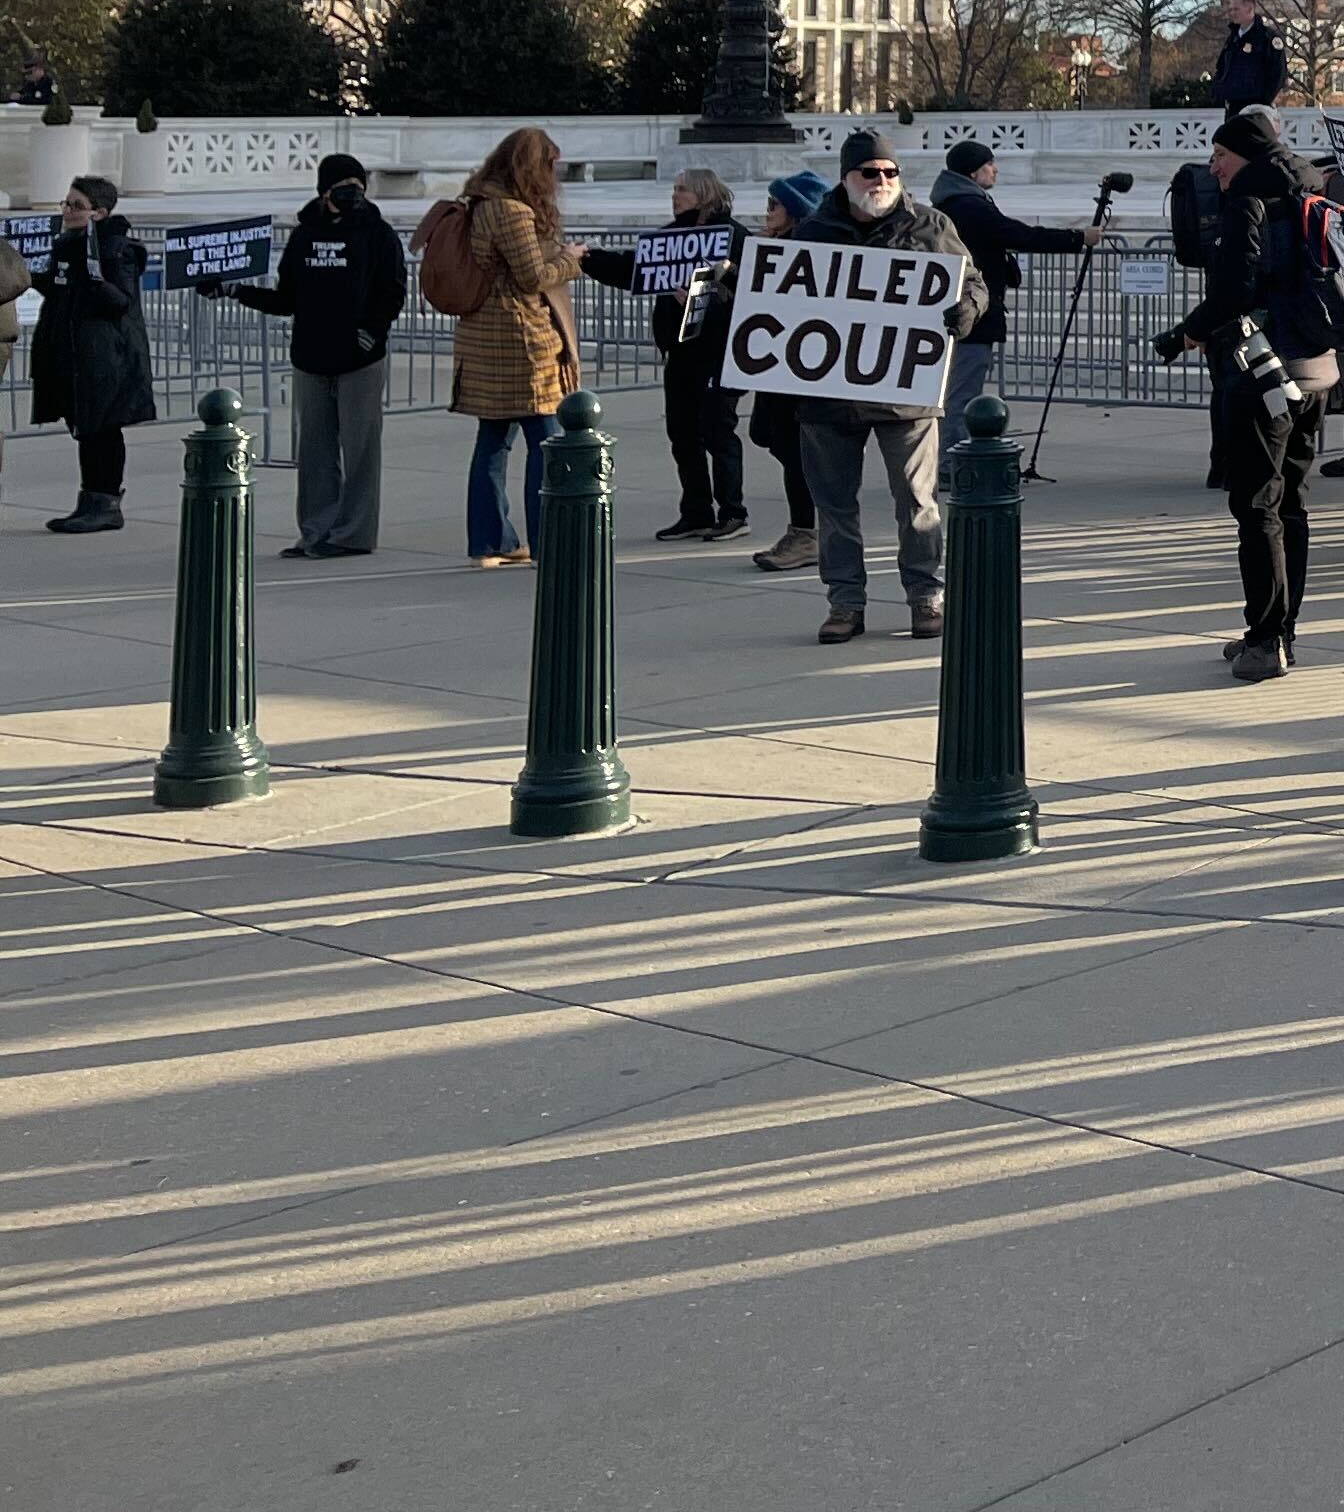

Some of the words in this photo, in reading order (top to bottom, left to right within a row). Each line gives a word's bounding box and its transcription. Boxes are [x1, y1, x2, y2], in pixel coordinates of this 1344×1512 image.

[9, 216, 52, 235] THESE
[166, 237, 186, 252] WILL
[187, 231, 228, 249] SUPREME
[229, 224, 272, 244] INJUSTICE
[312, 241, 346, 251] TRUMP
[636, 231, 730, 264] REMOVE
[192, 248, 206, 261] BE
[207, 246, 226, 260] THE
[226, 242, 247, 257] LAW
[304, 257, 347, 267] TRAITOR
[329, 250, 336, 258] A
[186, 263, 200, 276] OF
[202, 260, 221, 274] THE
[222, 255, 252, 271] LAND?
[641, 260, 712, 291] TRUM
[750, 244, 950, 306] FAILED
[731, 313, 945, 389] COUP
